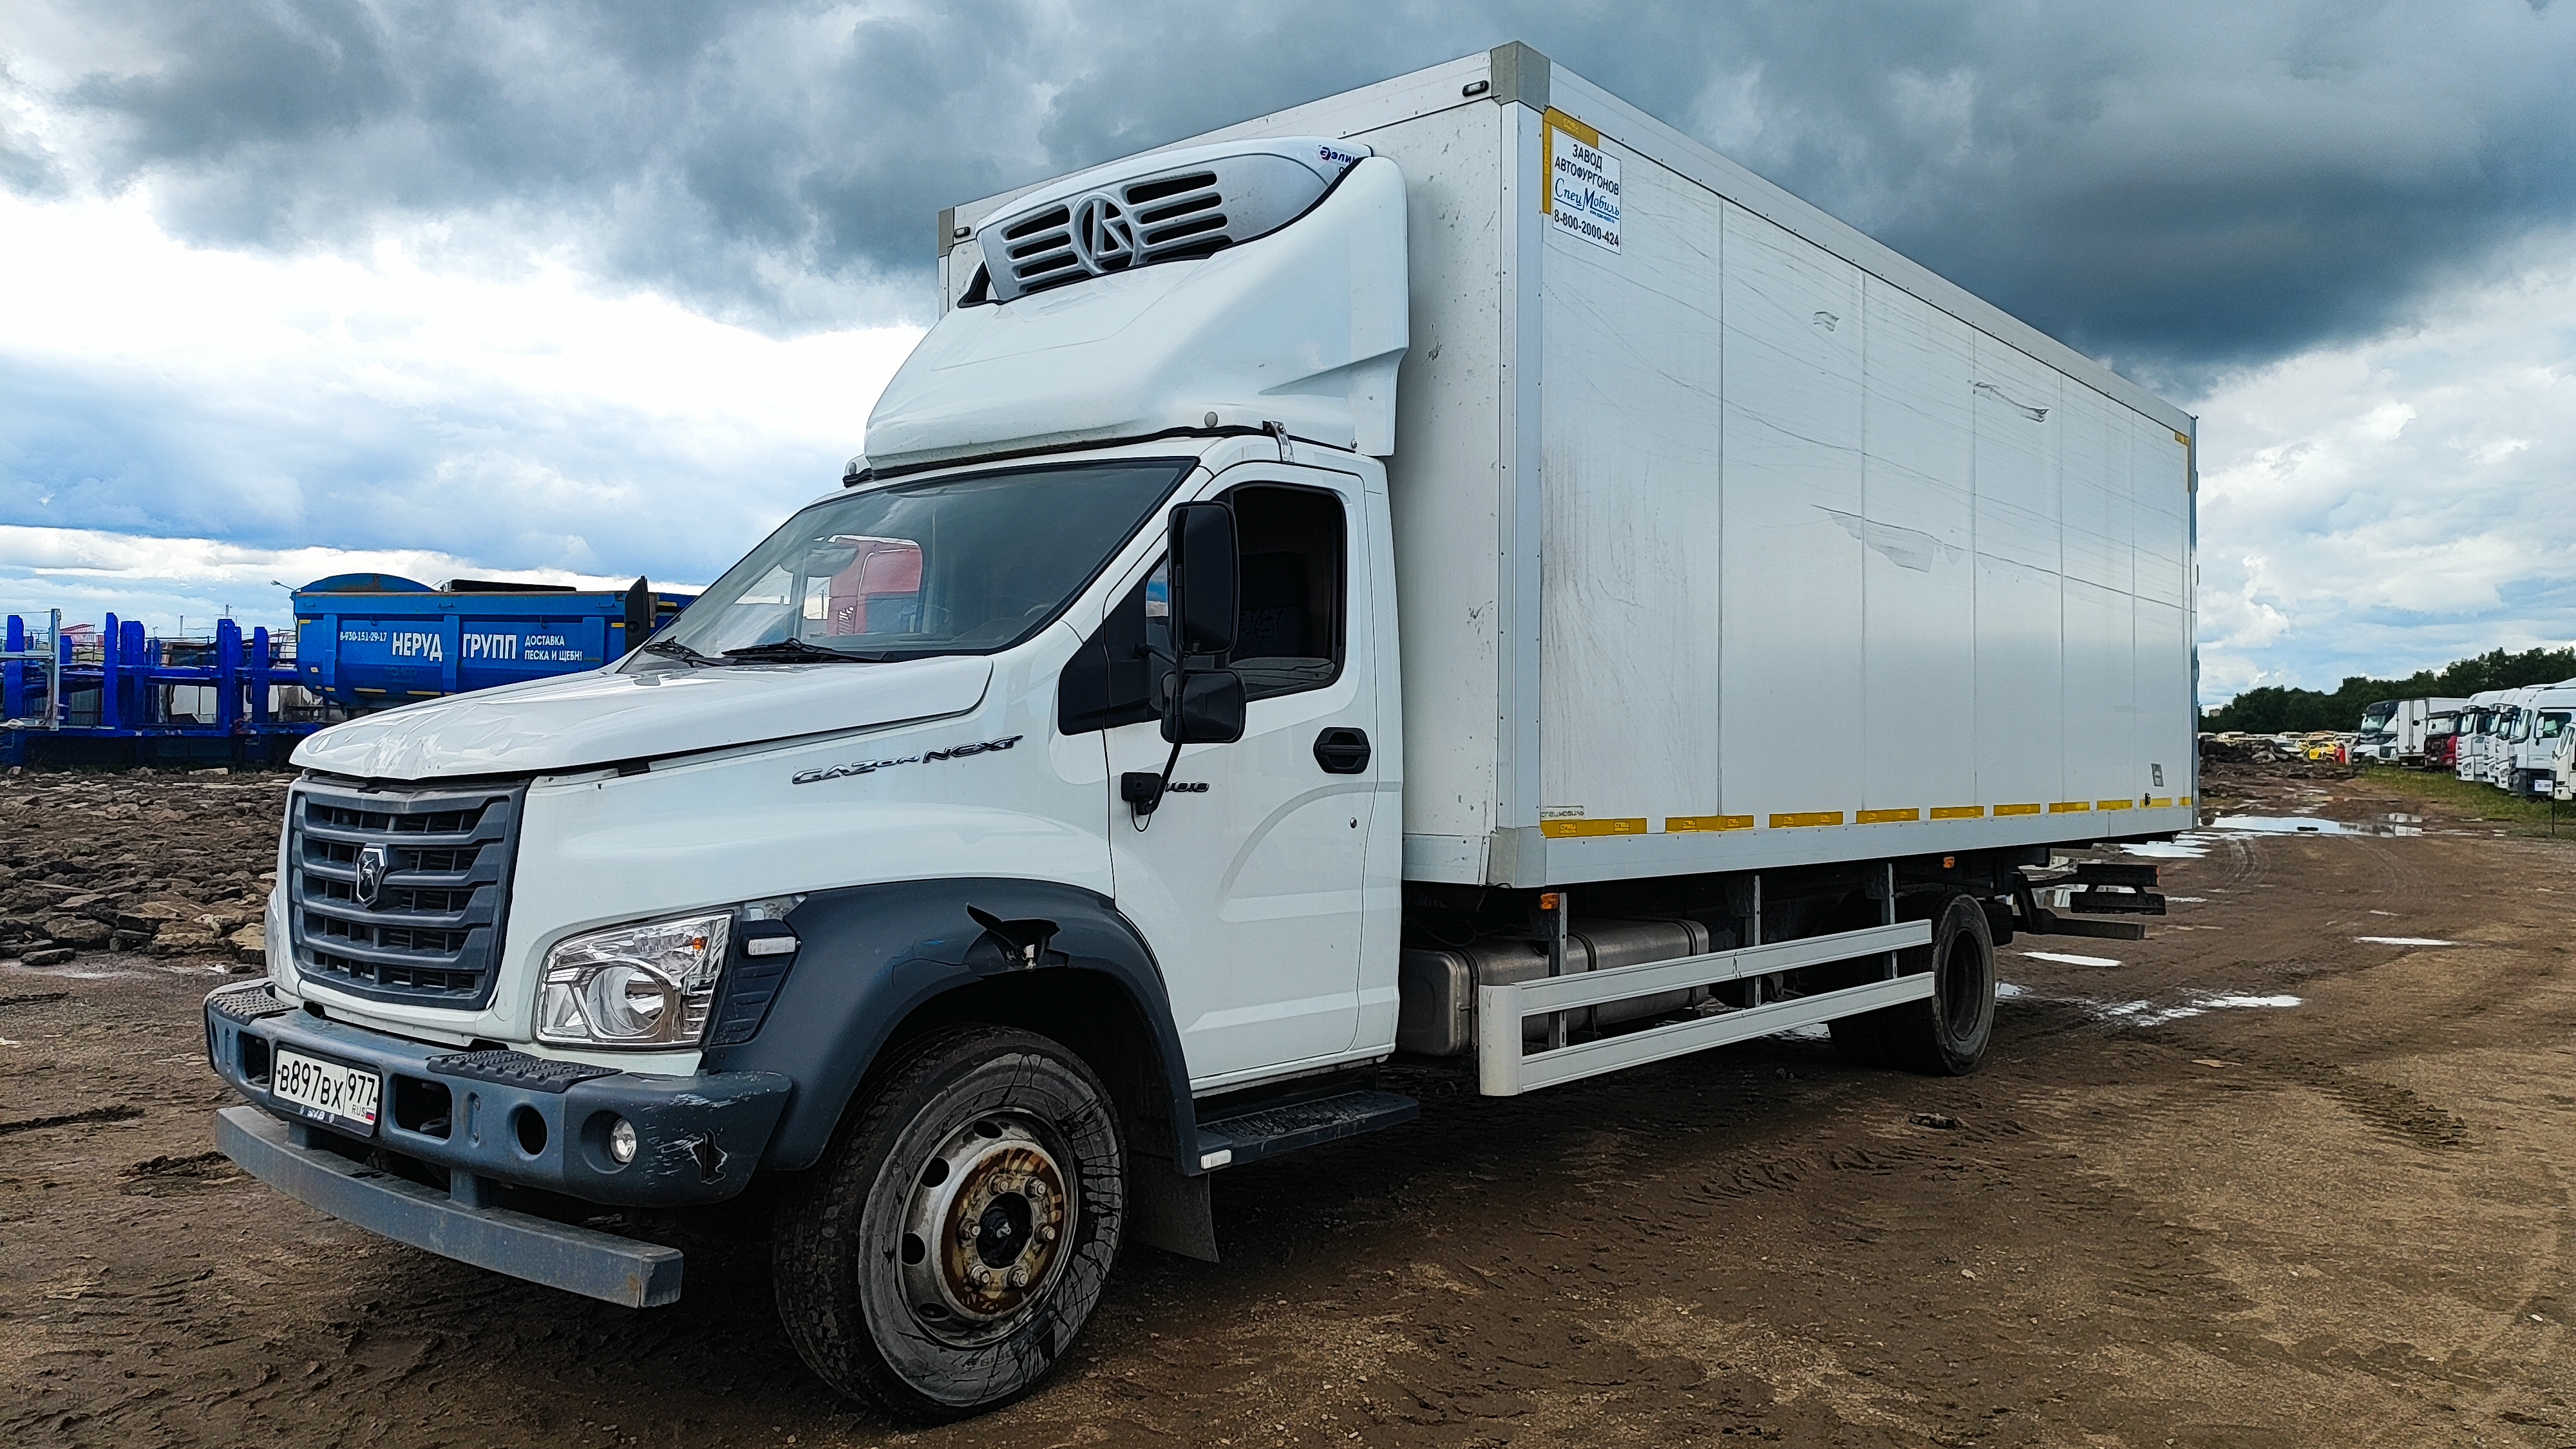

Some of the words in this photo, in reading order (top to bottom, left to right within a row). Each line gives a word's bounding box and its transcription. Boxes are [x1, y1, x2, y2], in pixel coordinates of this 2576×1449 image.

[1572, 144, 1602, 173] ЗАВОД
[1554, 155, 1619, 196] АВТОФУРГОНОВ
[1554, 209, 1619, 247] 8-800-2000-424
[392, 632, 442, 661] НЕРУД
[462, 633, 516, 659] ГРУПП
[524, 634, 565, 647] ДОСТАВКА
[524, 649, 549, 660] ПЕСКА
[551, 650, 557, 660] И
[279, 1059, 344, 1110] В897ВХ
[348, 1073, 375, 1106] 977
[351, 1104, 366, 1117] RUS
